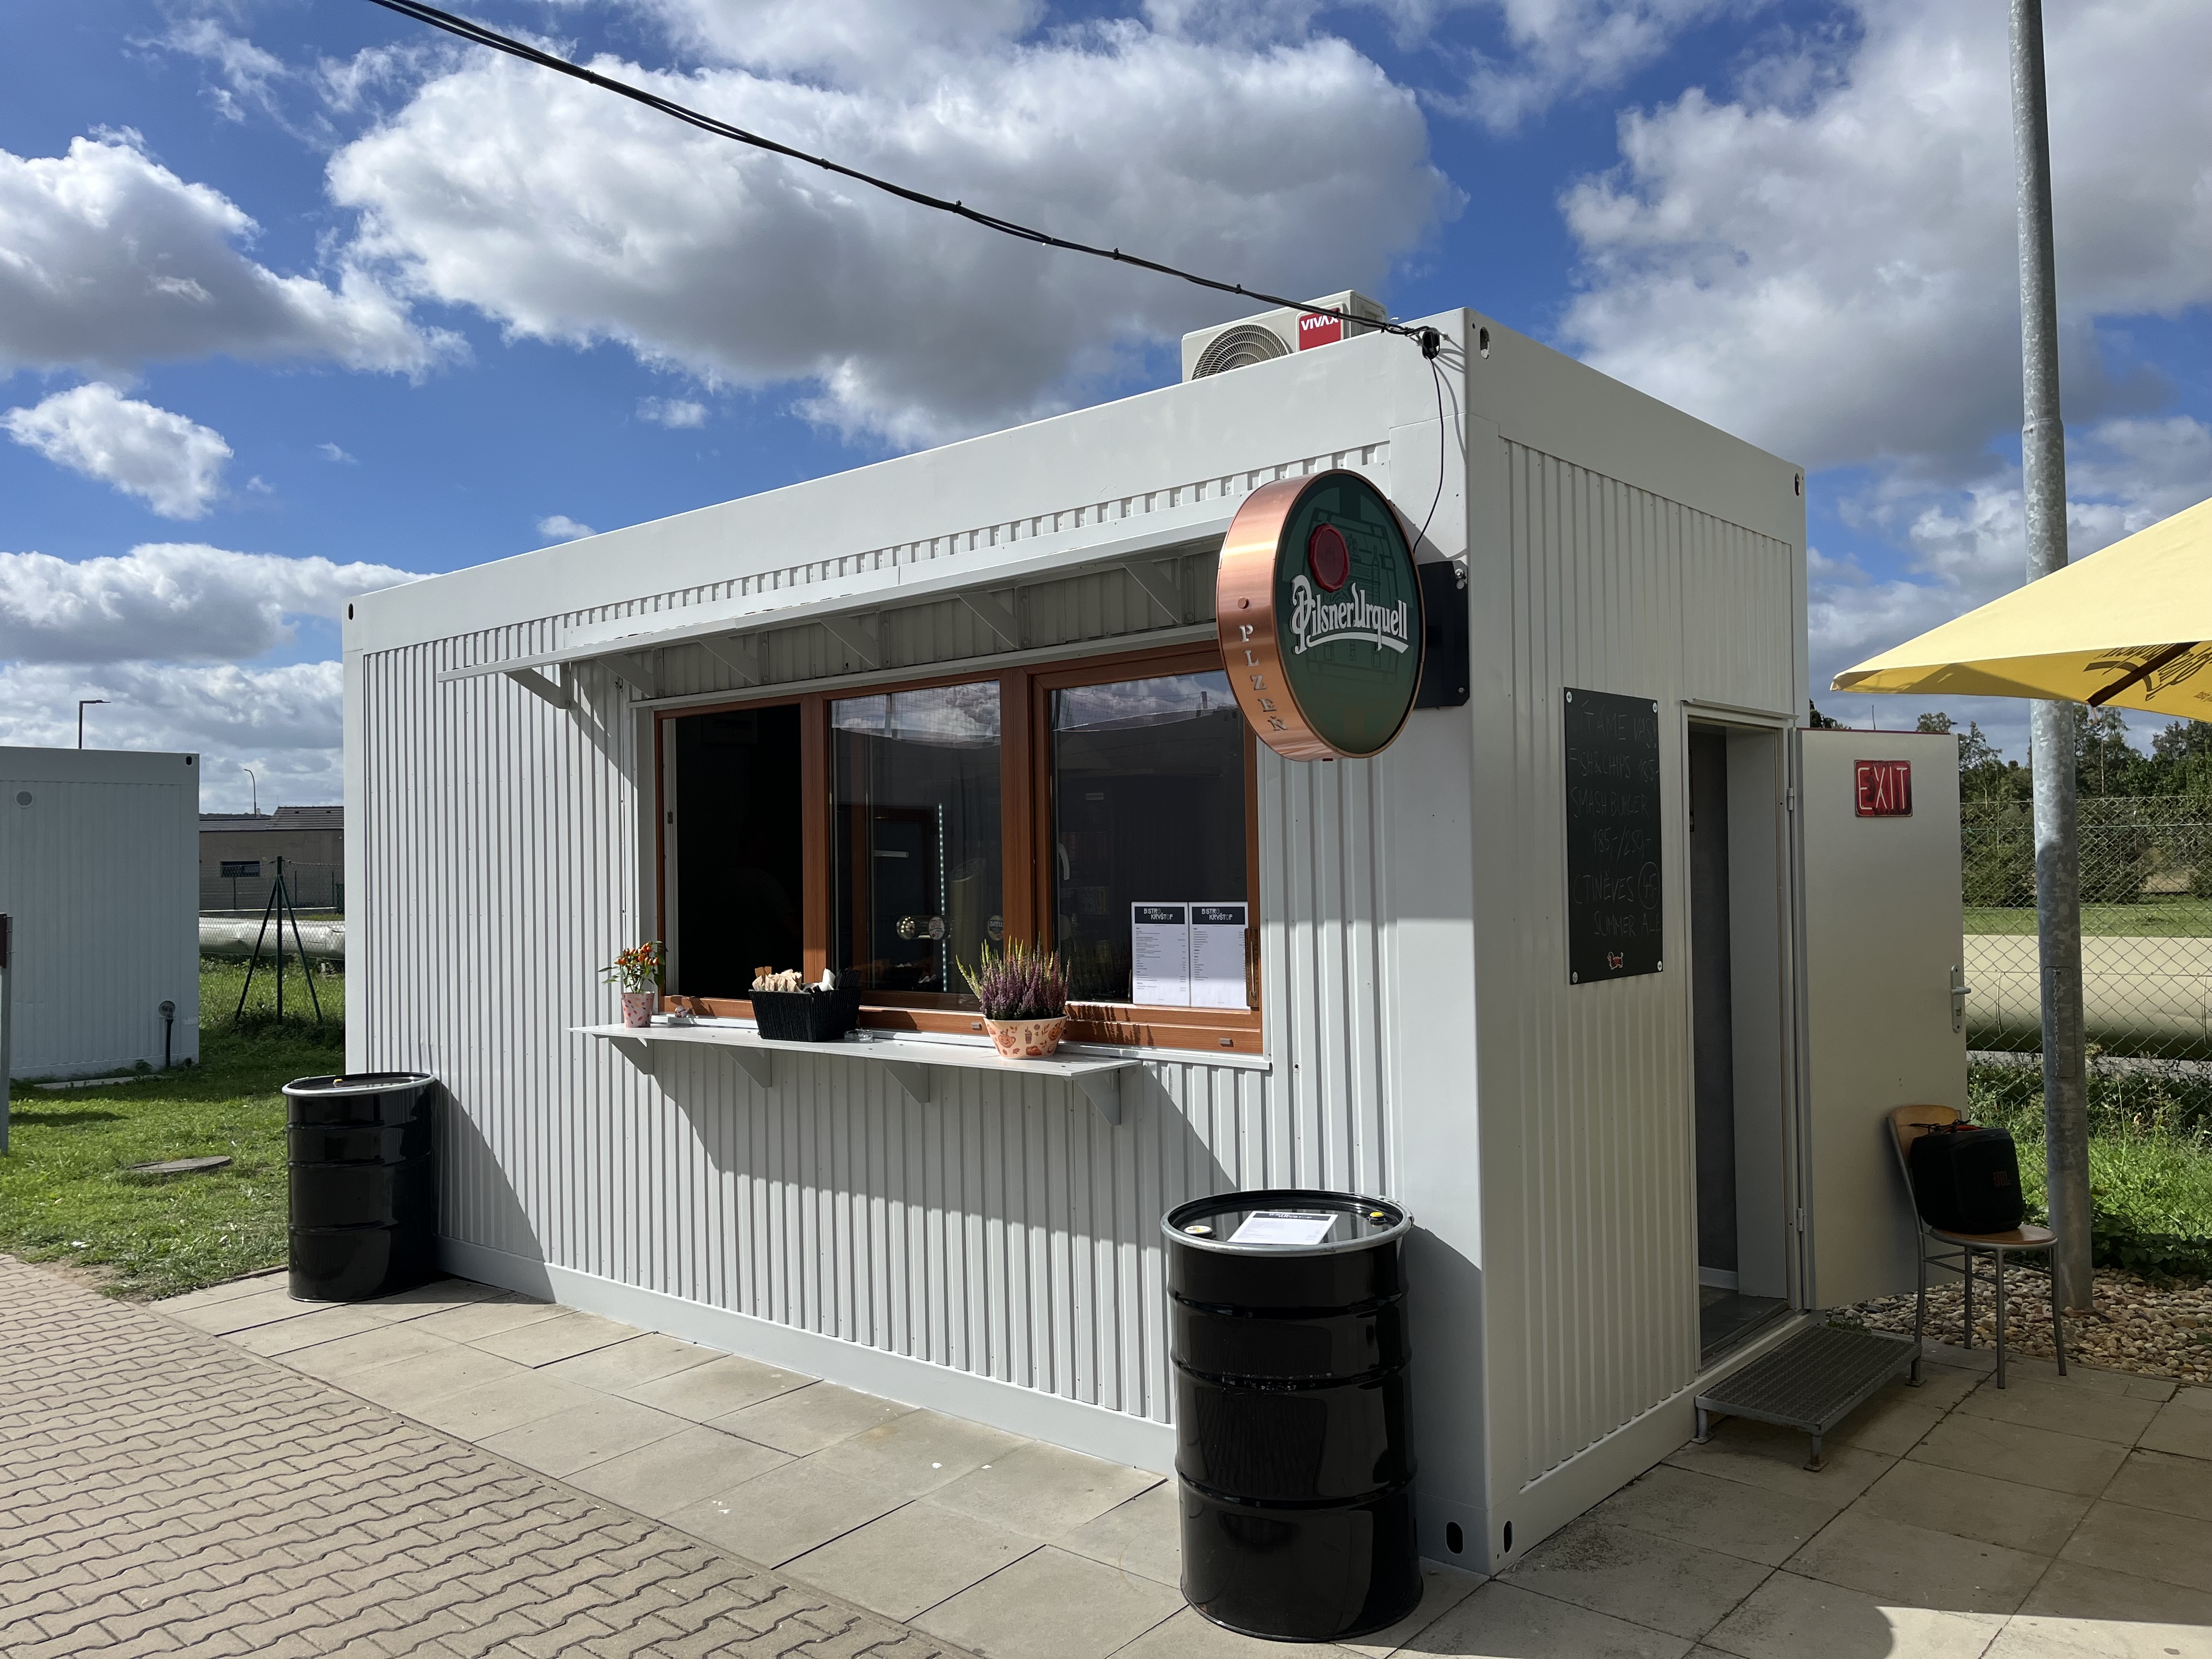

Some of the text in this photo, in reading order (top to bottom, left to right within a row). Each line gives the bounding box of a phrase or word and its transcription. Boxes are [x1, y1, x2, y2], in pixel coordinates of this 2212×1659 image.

[1290, 574, 1408, 654] Pilsner Urquell
[1239, 624, 1289, 731] PLZEŇ
[1568, 699, 1657, 749] VÍTÁME VÁS!
[1571, 786, 1650, 818] SMASH BURGER
[1858, 766, 1908, 810] EXIT
[1594, 911, 1661, 938] SUMMER ALE
